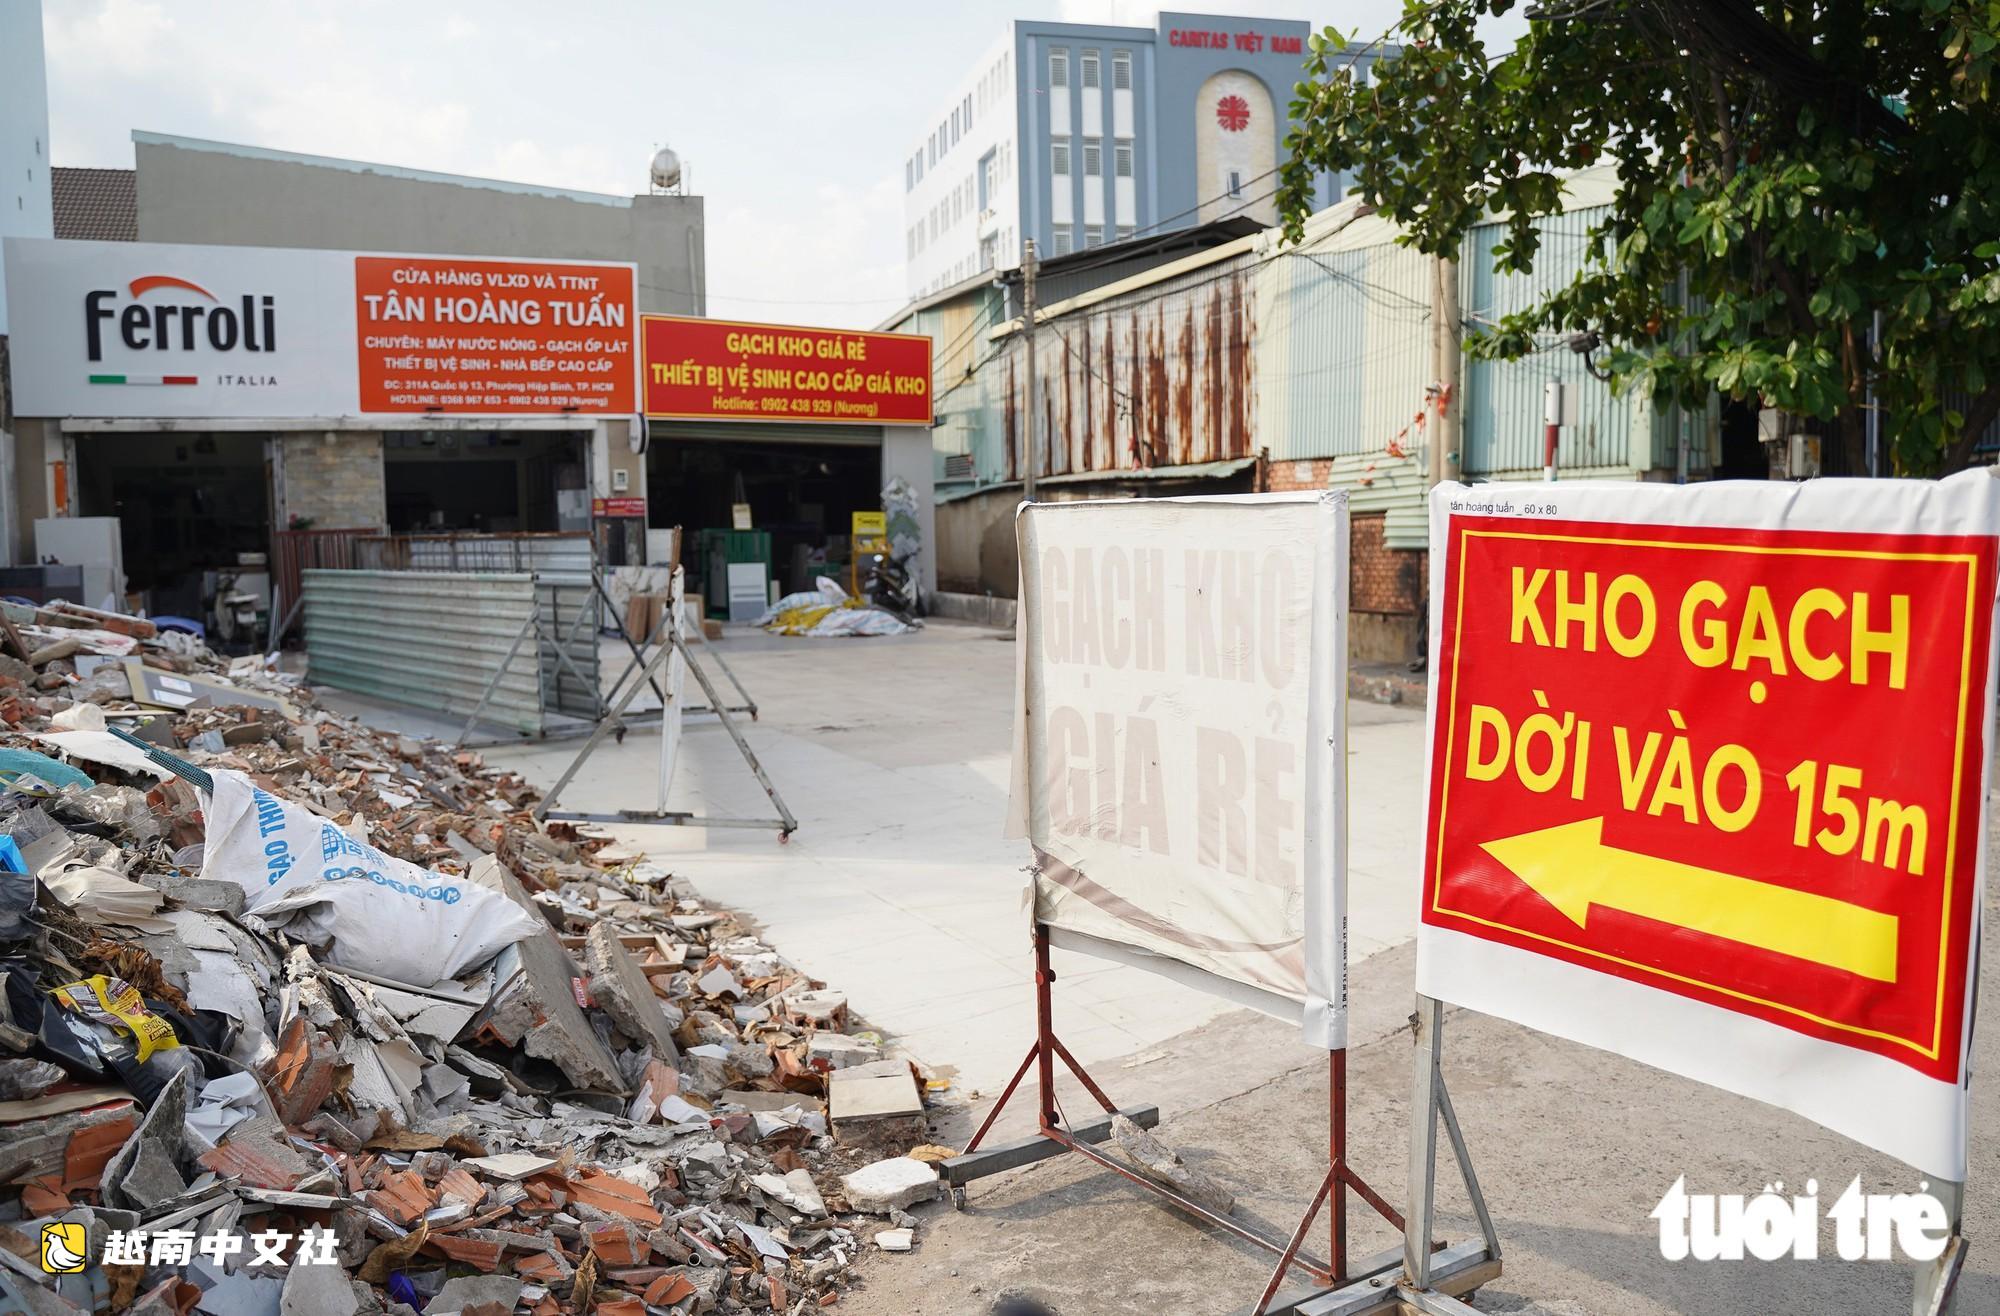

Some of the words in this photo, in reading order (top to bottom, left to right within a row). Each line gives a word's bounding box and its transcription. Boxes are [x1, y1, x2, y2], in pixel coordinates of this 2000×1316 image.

[1169, 29, 1229, 49] CARITAS
[392, 267, 431, 284] CỬA
[434, 268, 483, 286] HÀNG
[486, 273, 530, 289] VLXD
[532, 273, 556, 289] VÀ
[558, 275, 599, 291] TTNT
[363, 288, 426, 322] TÂN
[434, 291, 541, 326] HOÀNG
[547, 292, 625, 328] TUẤN
[364, 335, 424, 349] CHUYÊN:
[546, 340, 582, 354] GẠCH
[726, 332, 775, 360] GẠCH
[777, 335, 814, 358] KHO
[815, 336, 844, 360] GIÁ
[846, 336, 867, 361] RẺ
[384, 355, 422, 369] THIẾT
[424, 357, 438, 372] BỊ
[440, 356, 458, 372] VỆ
[460, 358, 491, 370] SINH
[500, 358, 528, 371] NHÀ
[530, 357, 556, 371] BẾP
[557, 360, 586, 372] CAO
[587, 357, 614, 372] CẤP
[218, 376, 278, 386] ITALIA
[651, 358, 703, 386] THIẾT
[706, 365, 725, 393] BỊ
[726, 362, 750, 394] VỆ
[752, 367, 792, 390] SINH
[794, 370, 831, 392] CAO
[832, 367, 864, 393] CẤP
[866, 369, 893, 394] GIÁ
[894, 375, 927, 396] KHO
[712, 396, 759, 410] Hotline:
[1465, 501, 1494, 514] hoàng
[1524, 503, 1536, 514] 60
[1545, 504, 1558, 515] 80
[1041, 546, 1166, 689] GẠCH
[1184, 549, 1298, 689] KHO
[1510, 565, 1657, 658] KHO
[1679, 580, 1910, 704] GẠCH
[1046, 695, 1171, 857] GIÁ
[1196, 700, 1298, 888] RẺ
[1465, 689, 1591, 801] DỜI
[1613, 709, 1762, 833] VÀO
[1785, 760, 1927, 876] 15m
